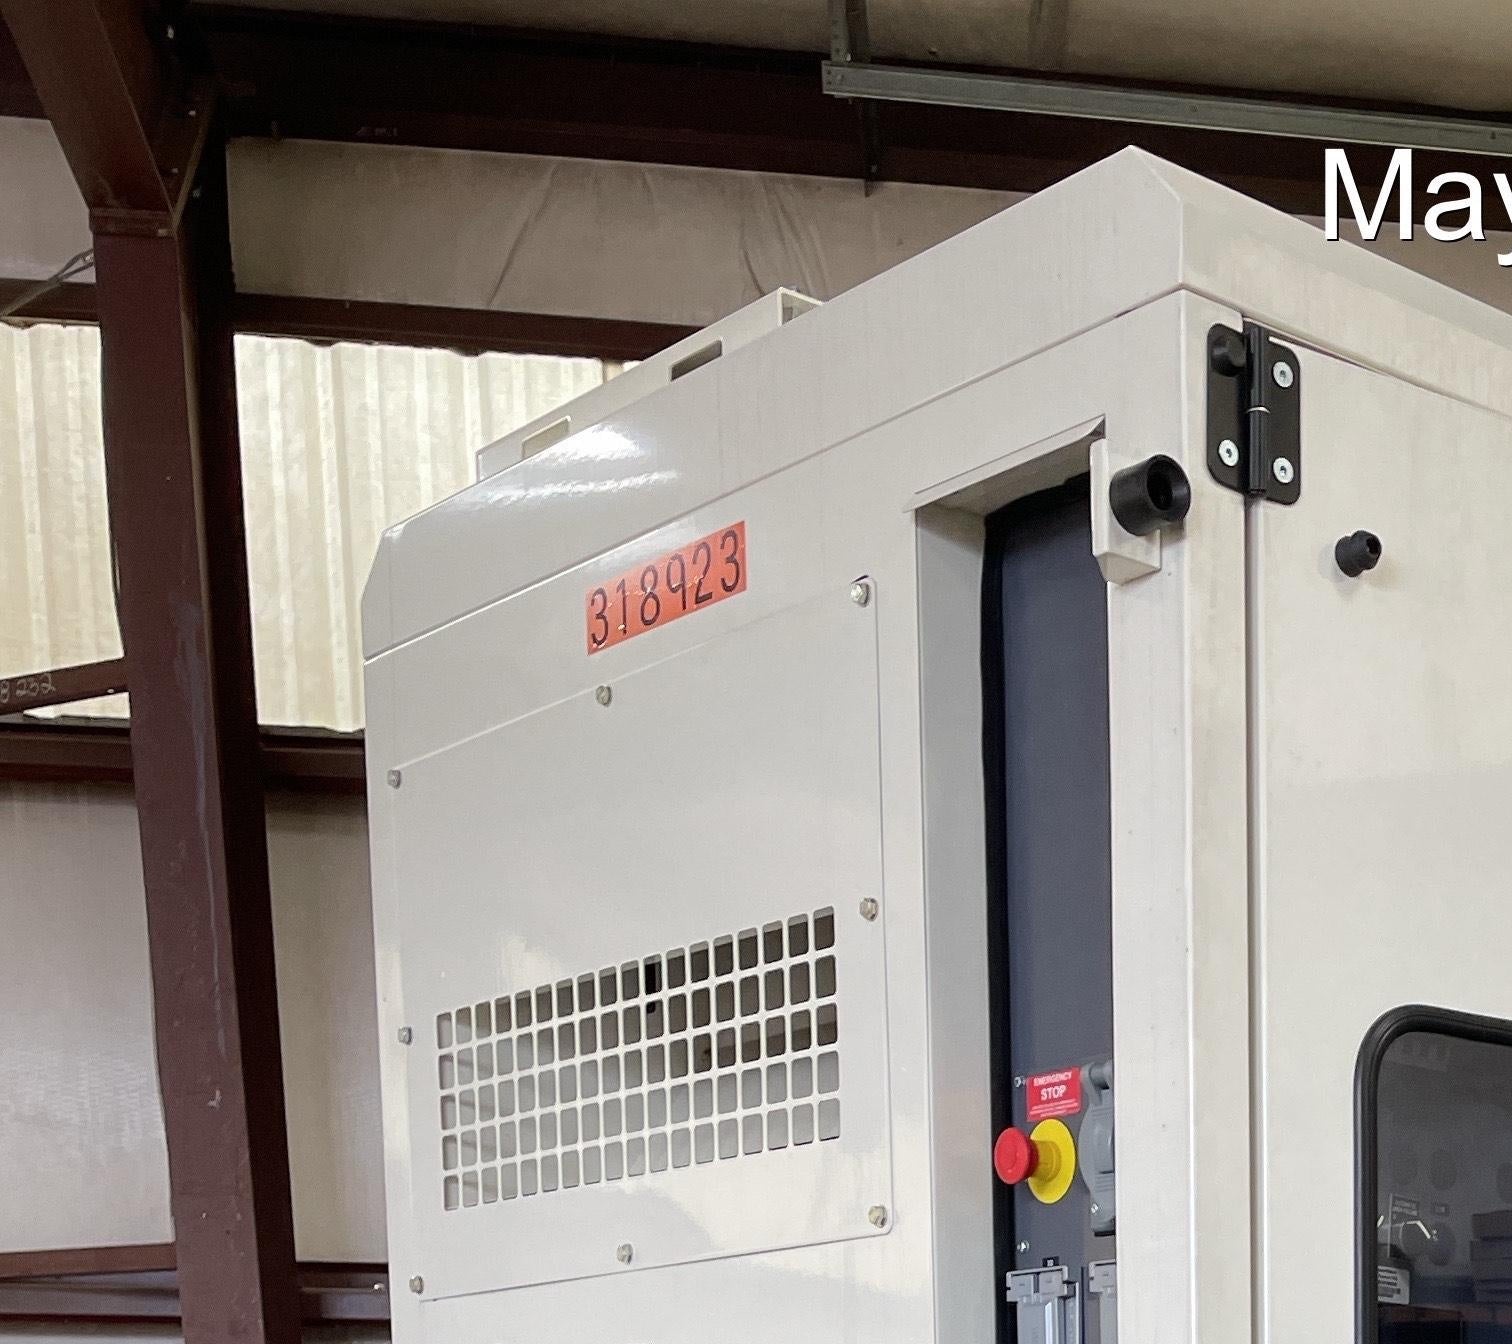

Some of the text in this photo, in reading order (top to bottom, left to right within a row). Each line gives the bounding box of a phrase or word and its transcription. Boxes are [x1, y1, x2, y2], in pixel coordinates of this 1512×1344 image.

[590, 528, 741, 646] 318923
[1033, 1071, 1073, 1087] EMERGENCY
[1040, 1084, 1067, 1101] STOP
